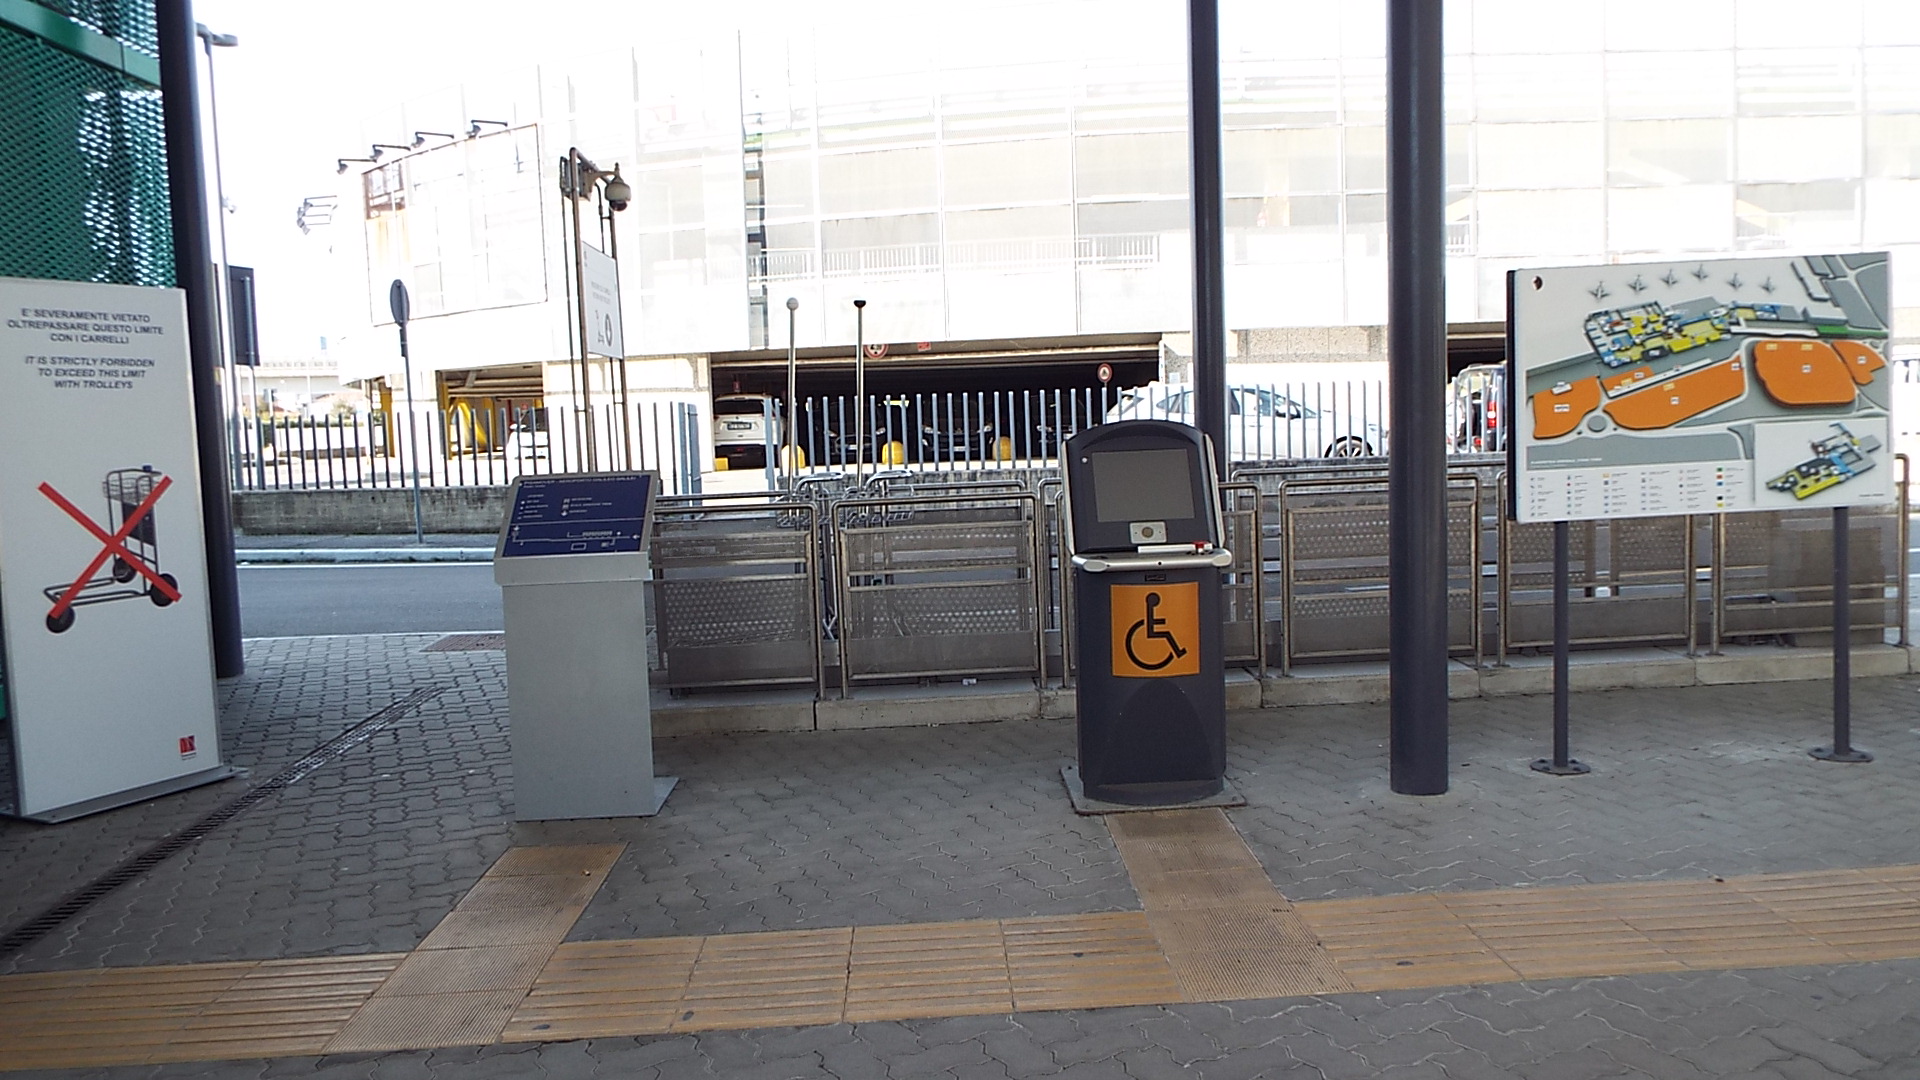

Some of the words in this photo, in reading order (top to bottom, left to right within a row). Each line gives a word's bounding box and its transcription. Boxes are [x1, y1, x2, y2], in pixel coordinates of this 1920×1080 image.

[34, 309, 109, 320] SEVERAMENTE
[111, 313, 150, 323] VIETATO
[7, 319, 91, 331] OLTREPASSARE
[92, 323, 133, 333] QUESTO
[134, 326, 164, 335] LIMITE
[50, 333, 73, 342] CON
[80, 334, 129, 344] CARRELLI
[25, 356, 35, 365] IT
[38, 356, 48, 365] IS
[50, 356, 98, 366] STRICTLY
[100, 357, 155, 367] FORBIDDEN
[38, 368, 52, 377] TO
[55, 368, 96, 377] EXCEED
[98, 369, 120, 378] THIS
[121, 369, 146, 378] LIMIT
[54, 380, 80, 389] WITH
[83, 380, 133, 389] TROLLEYS
